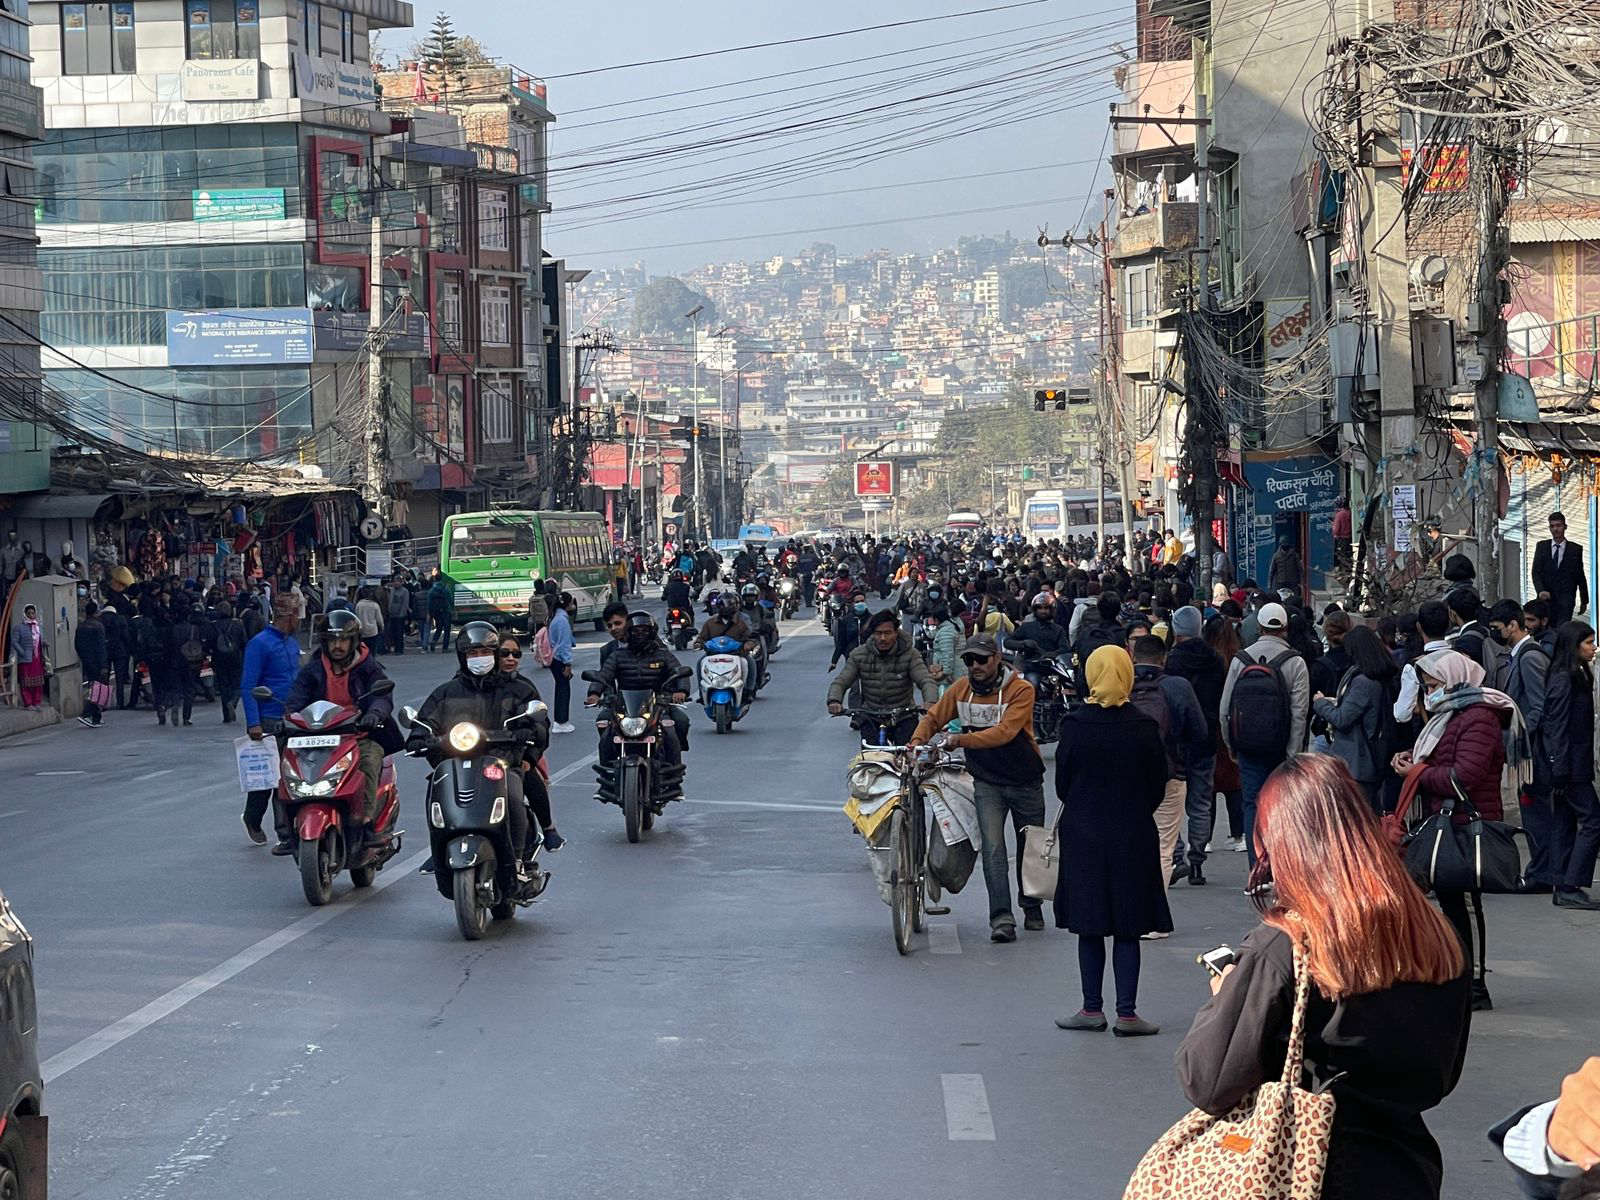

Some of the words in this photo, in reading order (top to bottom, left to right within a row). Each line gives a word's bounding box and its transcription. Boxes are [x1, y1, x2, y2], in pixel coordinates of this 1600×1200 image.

[186, 66, 232, 77] Panorama
[234, 65, 255, 77] Cafe
[153, 104, 188, 122] The
[1274, 493, 1308, 510] पसल
